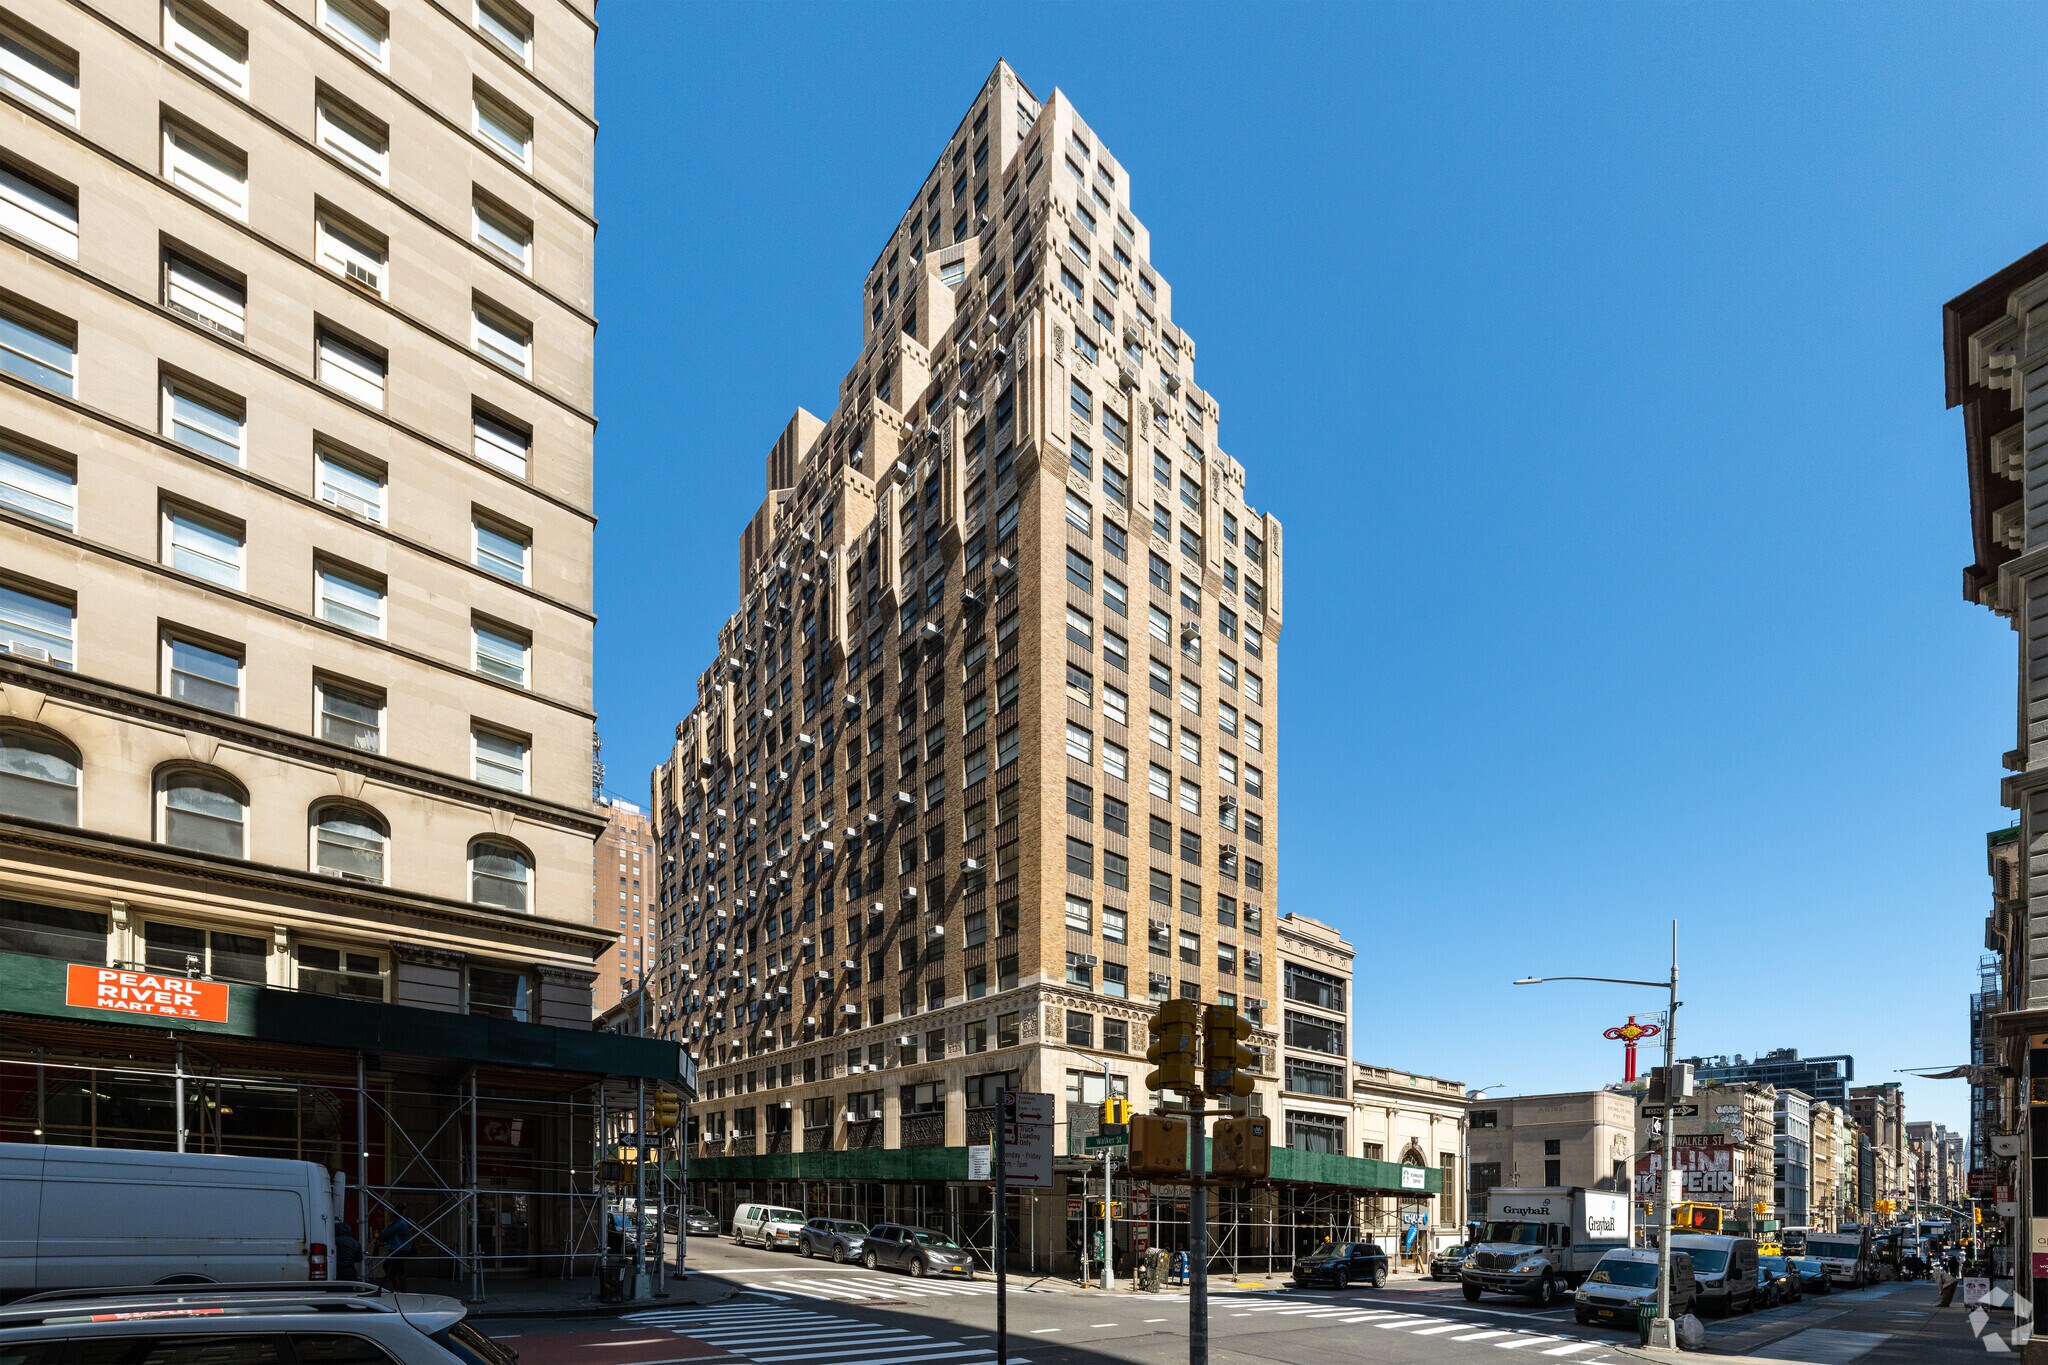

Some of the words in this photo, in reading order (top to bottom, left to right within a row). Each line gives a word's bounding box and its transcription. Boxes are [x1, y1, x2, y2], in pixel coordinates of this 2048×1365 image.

[98, 970, 201, 995] PEARL
[98, 984, 193, 1007] RIVER
[97, 998, 154, 1012] MART
[1020, 1125, 1034, 1133] Truck
[1020, 1133, 1041, 1141] Loading
[1096, 1137, 1115, 1145] Walker
[1116, 1136, 1122, 1144] St
[1676, 1136, 1709, 1146] WALKER
[1020, 1139, 1031, 1147] Only
[1026, 1152, 1041, 1160] Friday
[1503, 1206, 1550, 1216] GraybaR
[1588, 1216, 1615, 1235] GraybaR
